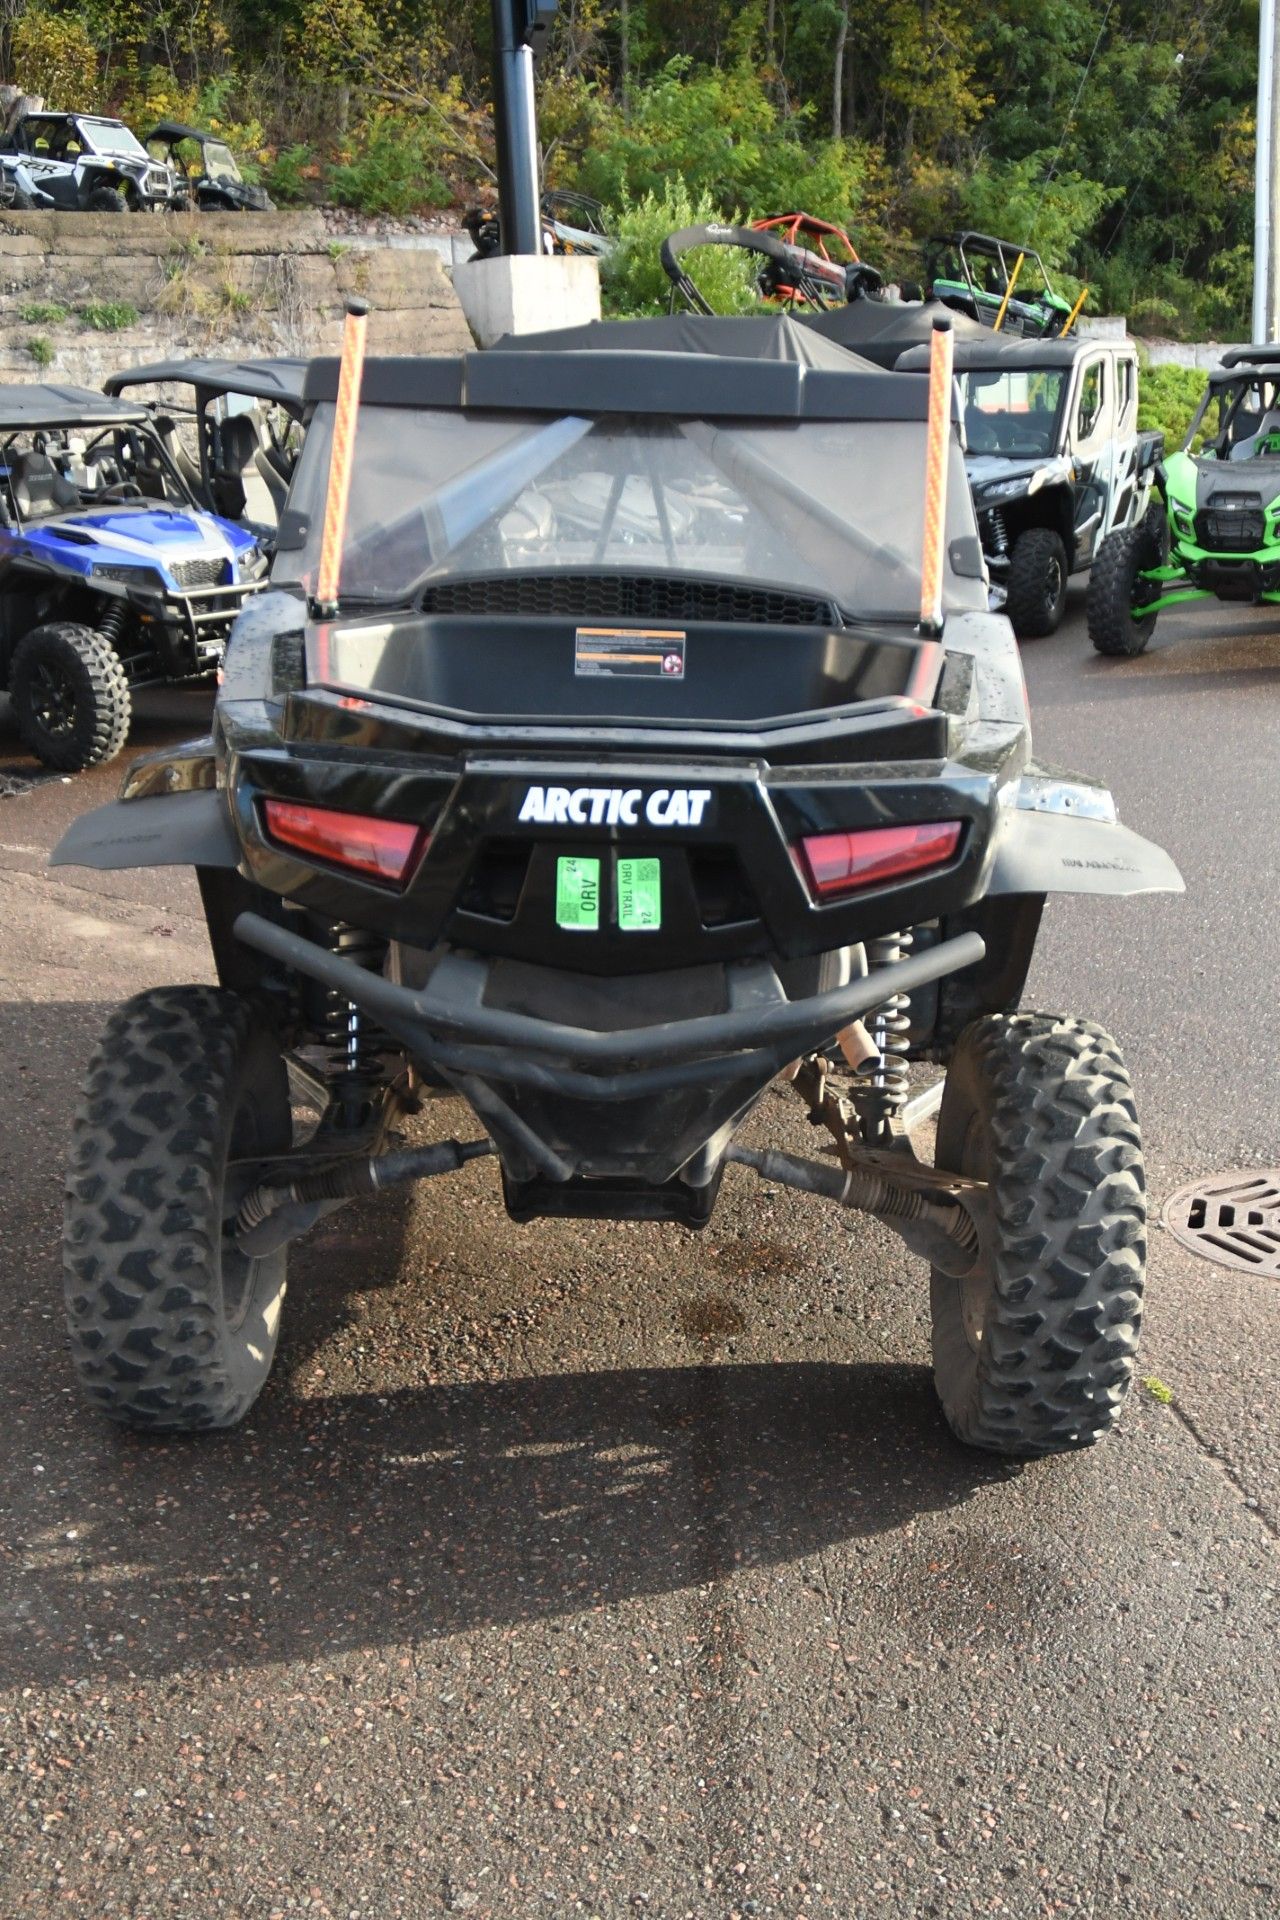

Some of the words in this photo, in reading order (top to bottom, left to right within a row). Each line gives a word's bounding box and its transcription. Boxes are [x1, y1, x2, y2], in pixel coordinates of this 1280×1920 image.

[518, 786, 642, 824] ARCTIC
[645, 789, 712, 825] CAT
[566, 859, 577, 873] 24
[622, 863, 632, 885] ORV
[580, 879, 597, 912] ORV
[622, 890, 633, 919] TRAIL
[641, 911, 652, 924] 24
